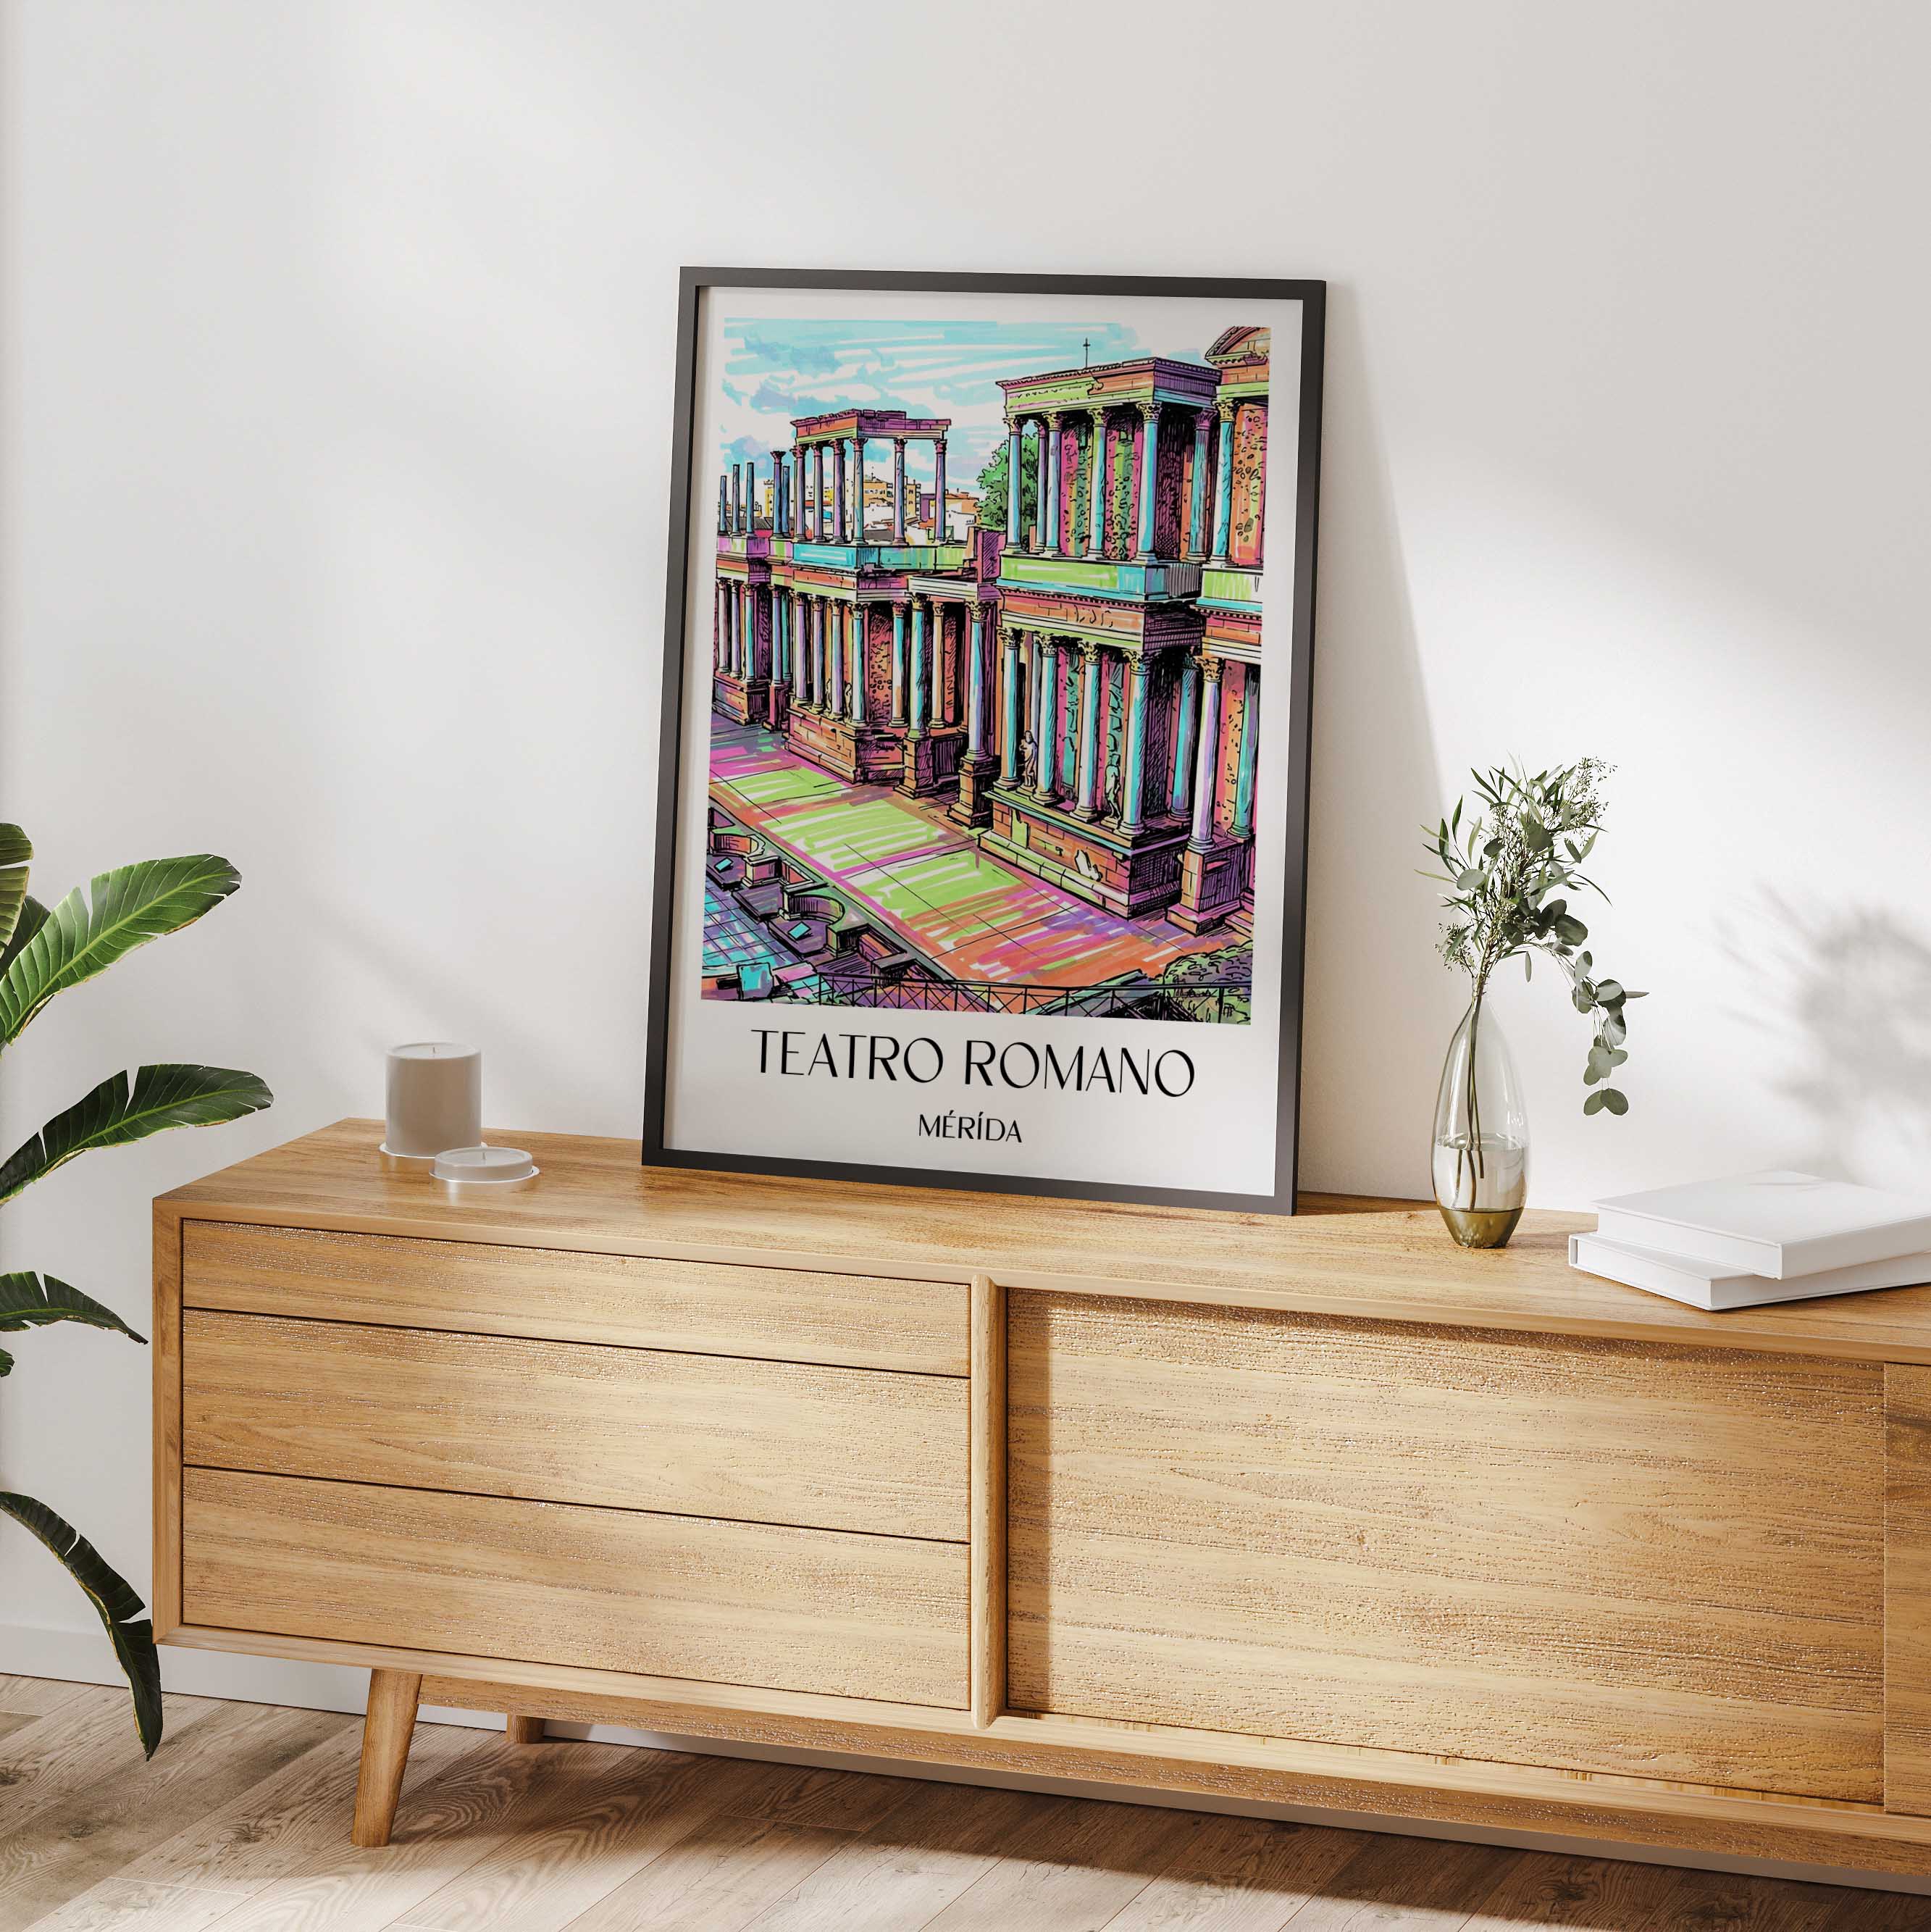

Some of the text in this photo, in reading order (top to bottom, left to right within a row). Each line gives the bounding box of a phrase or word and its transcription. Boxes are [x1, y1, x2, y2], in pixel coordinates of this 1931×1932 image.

[750, 1029, 1195, 1097] TEATRO ROMANO
[918, 1109, 1023, 1143] MÉRÍDA
